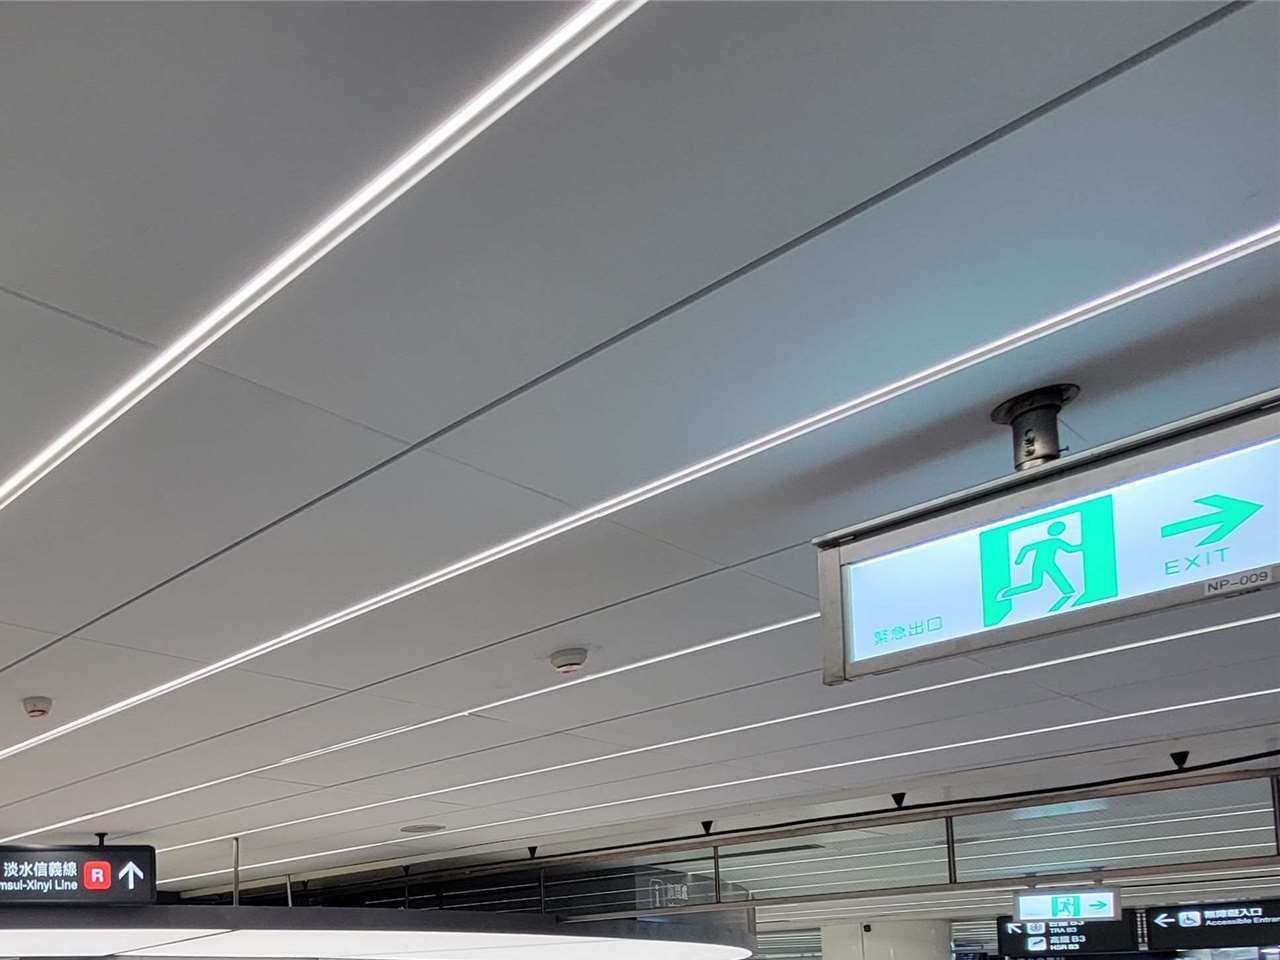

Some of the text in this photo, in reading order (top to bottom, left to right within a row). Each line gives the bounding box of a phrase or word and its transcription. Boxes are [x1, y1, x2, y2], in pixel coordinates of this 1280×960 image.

[1164, 547, 1231, 575] EXIT
[1206, 571, 1269, 593] NP-009
[873, 616, 943, 646] 緊急出口
[3, 861, 78, 877] 淡水信義線
[91, 868, 104, 883] R
[54, 879, 78, 890] Line
